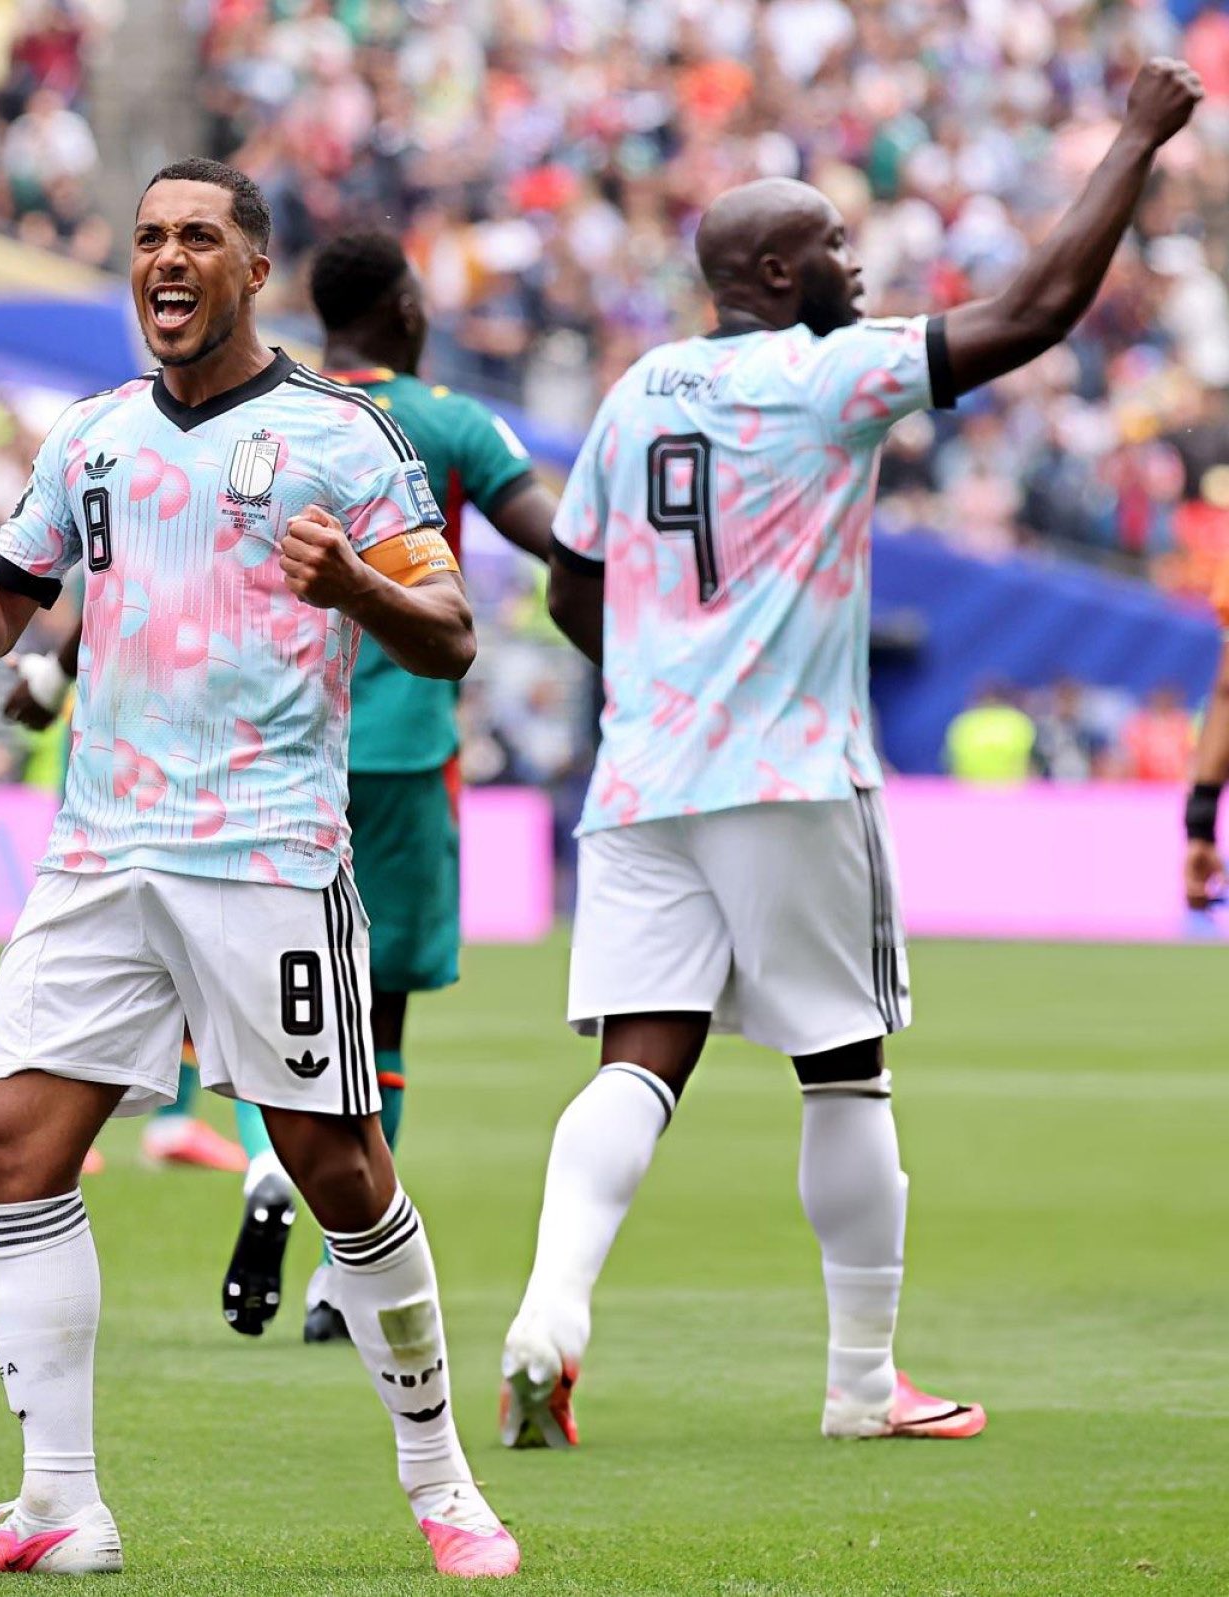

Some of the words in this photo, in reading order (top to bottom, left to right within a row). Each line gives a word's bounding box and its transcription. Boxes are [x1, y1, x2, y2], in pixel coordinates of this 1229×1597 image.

[83, 487, 113, 575] 8
[648, 433, 718, 606] 9
[280, 950, 324, 1036] 8
